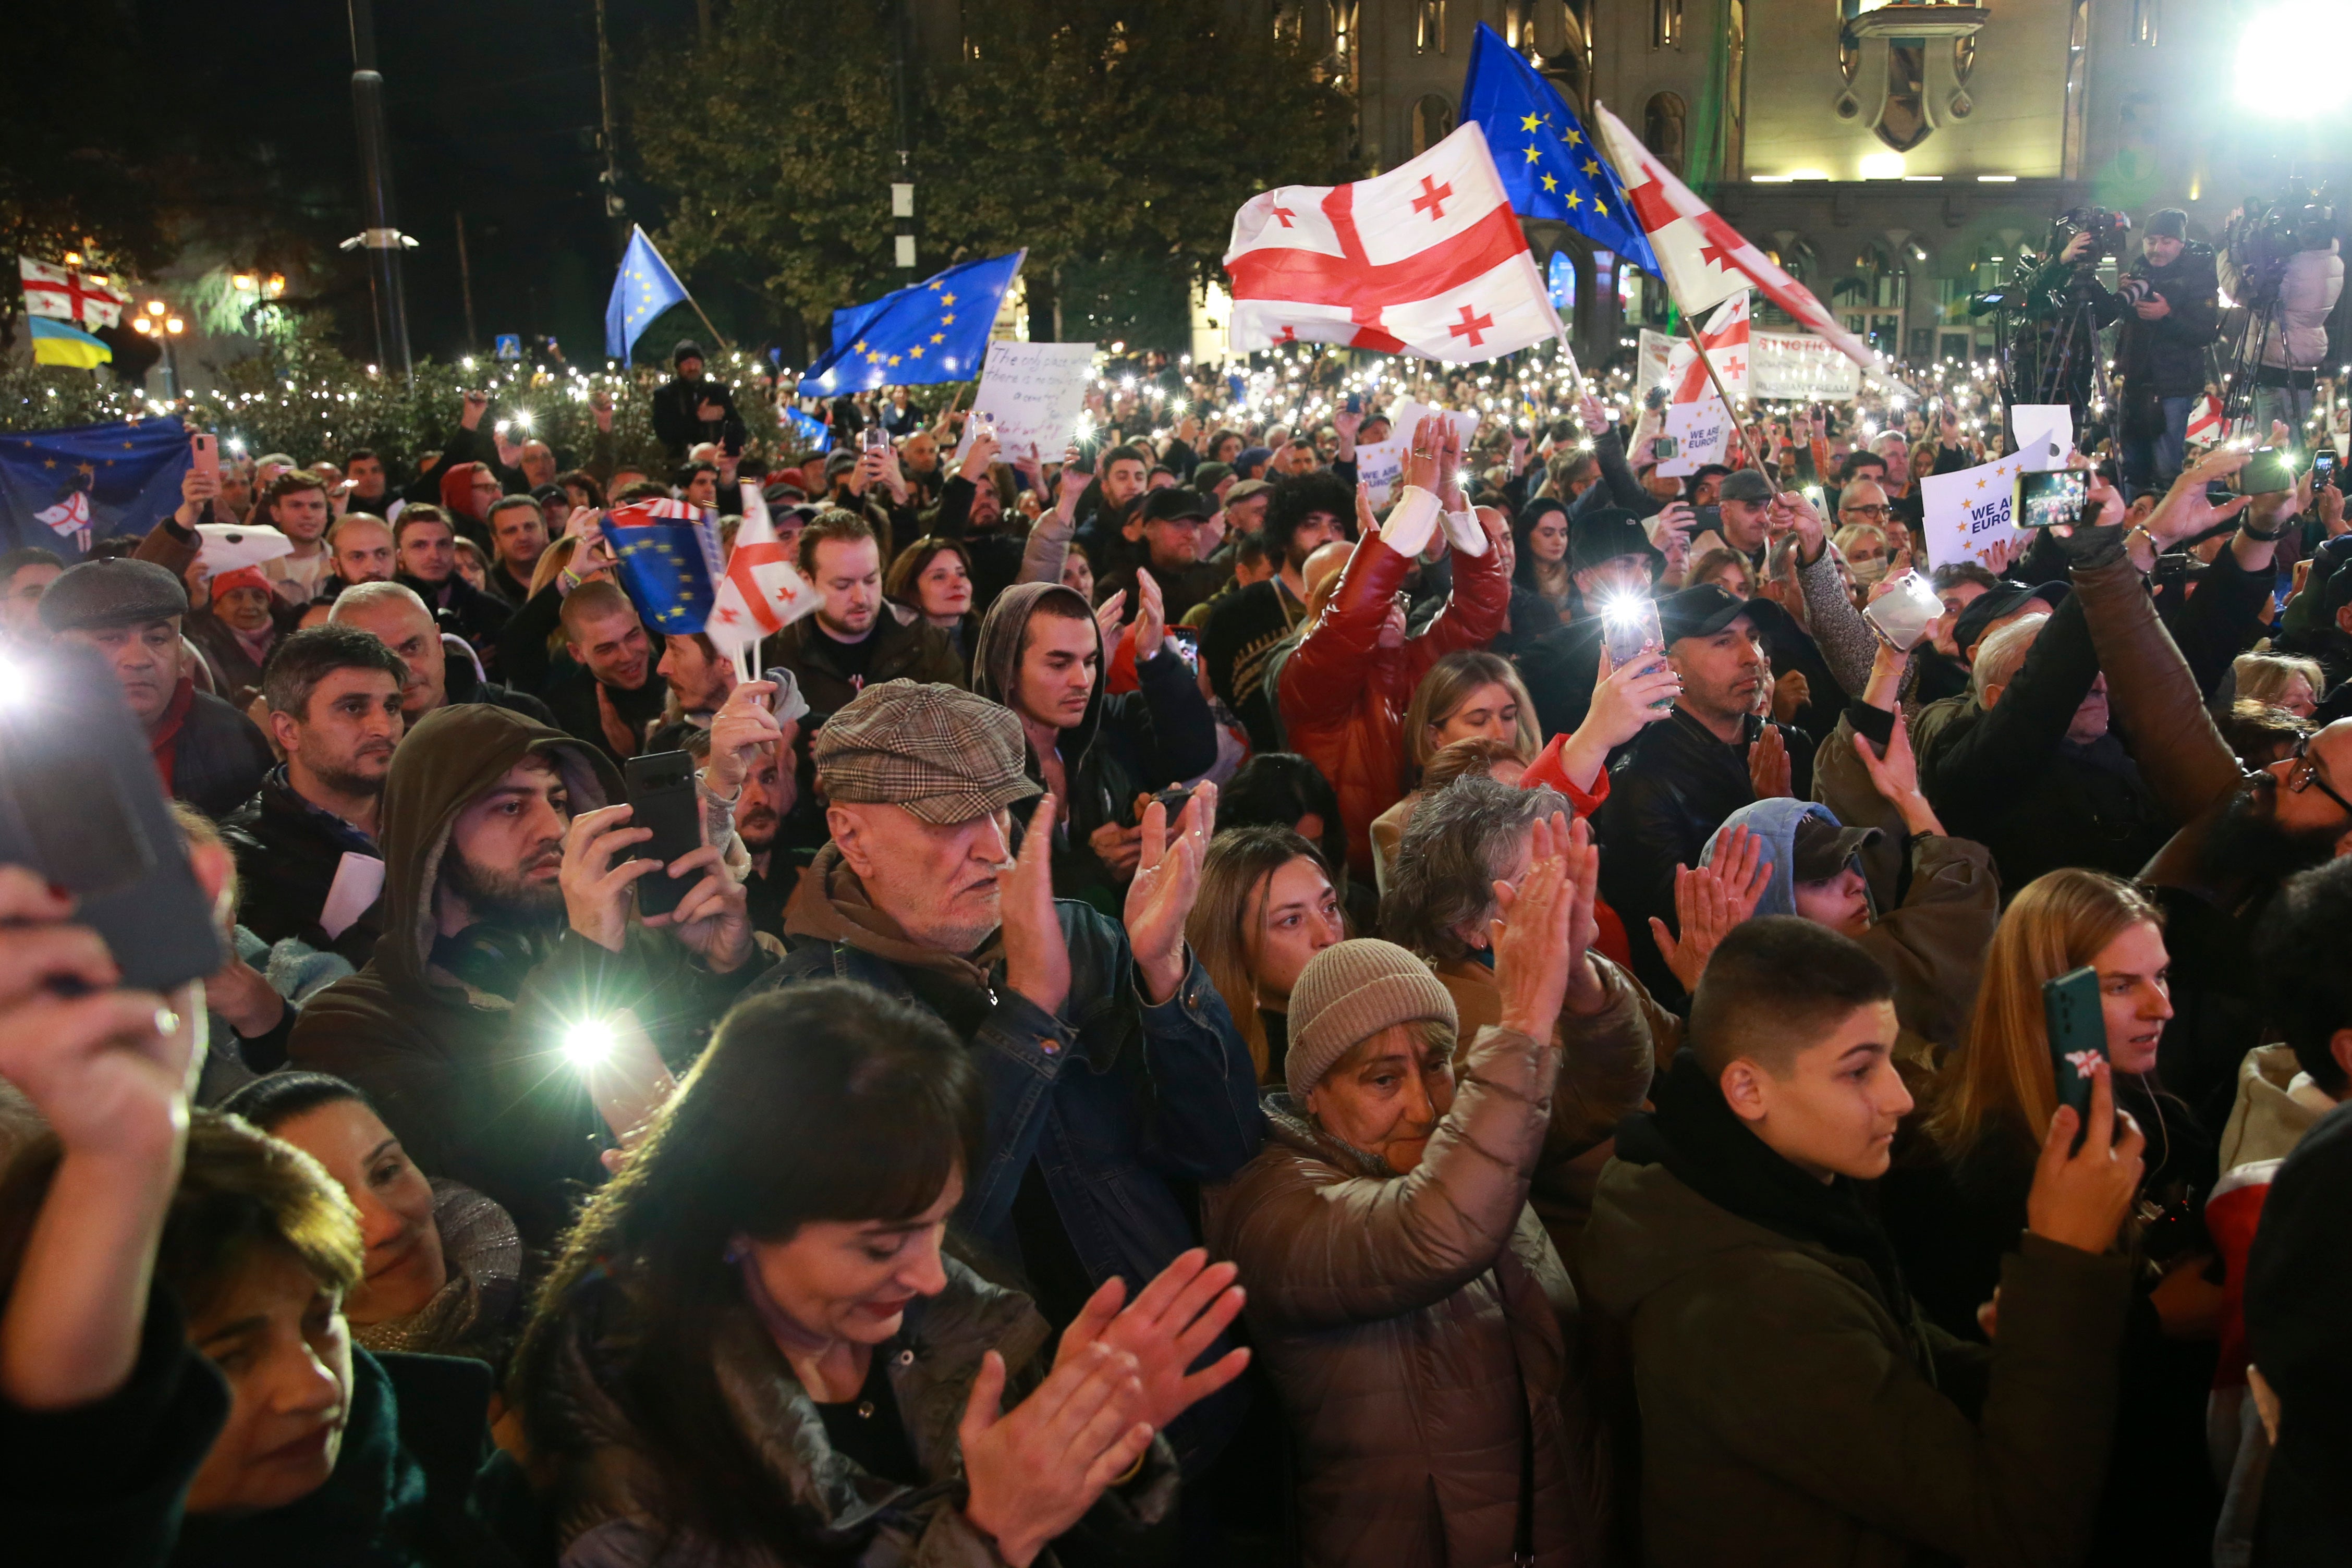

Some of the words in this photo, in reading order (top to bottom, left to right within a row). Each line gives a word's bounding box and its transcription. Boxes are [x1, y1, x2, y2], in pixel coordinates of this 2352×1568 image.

[1690, 430, 1704, 439] WE
[1707, 425, 1720, 437] ARE
[1361, 470, 1378, 479] WE
[1382, 464, 1398, 476] ARE
[1369, 476, 1392, 487] URO
[1971, 503, 1995, 521] WE
[1972, 510, 2010, 534] EURO
